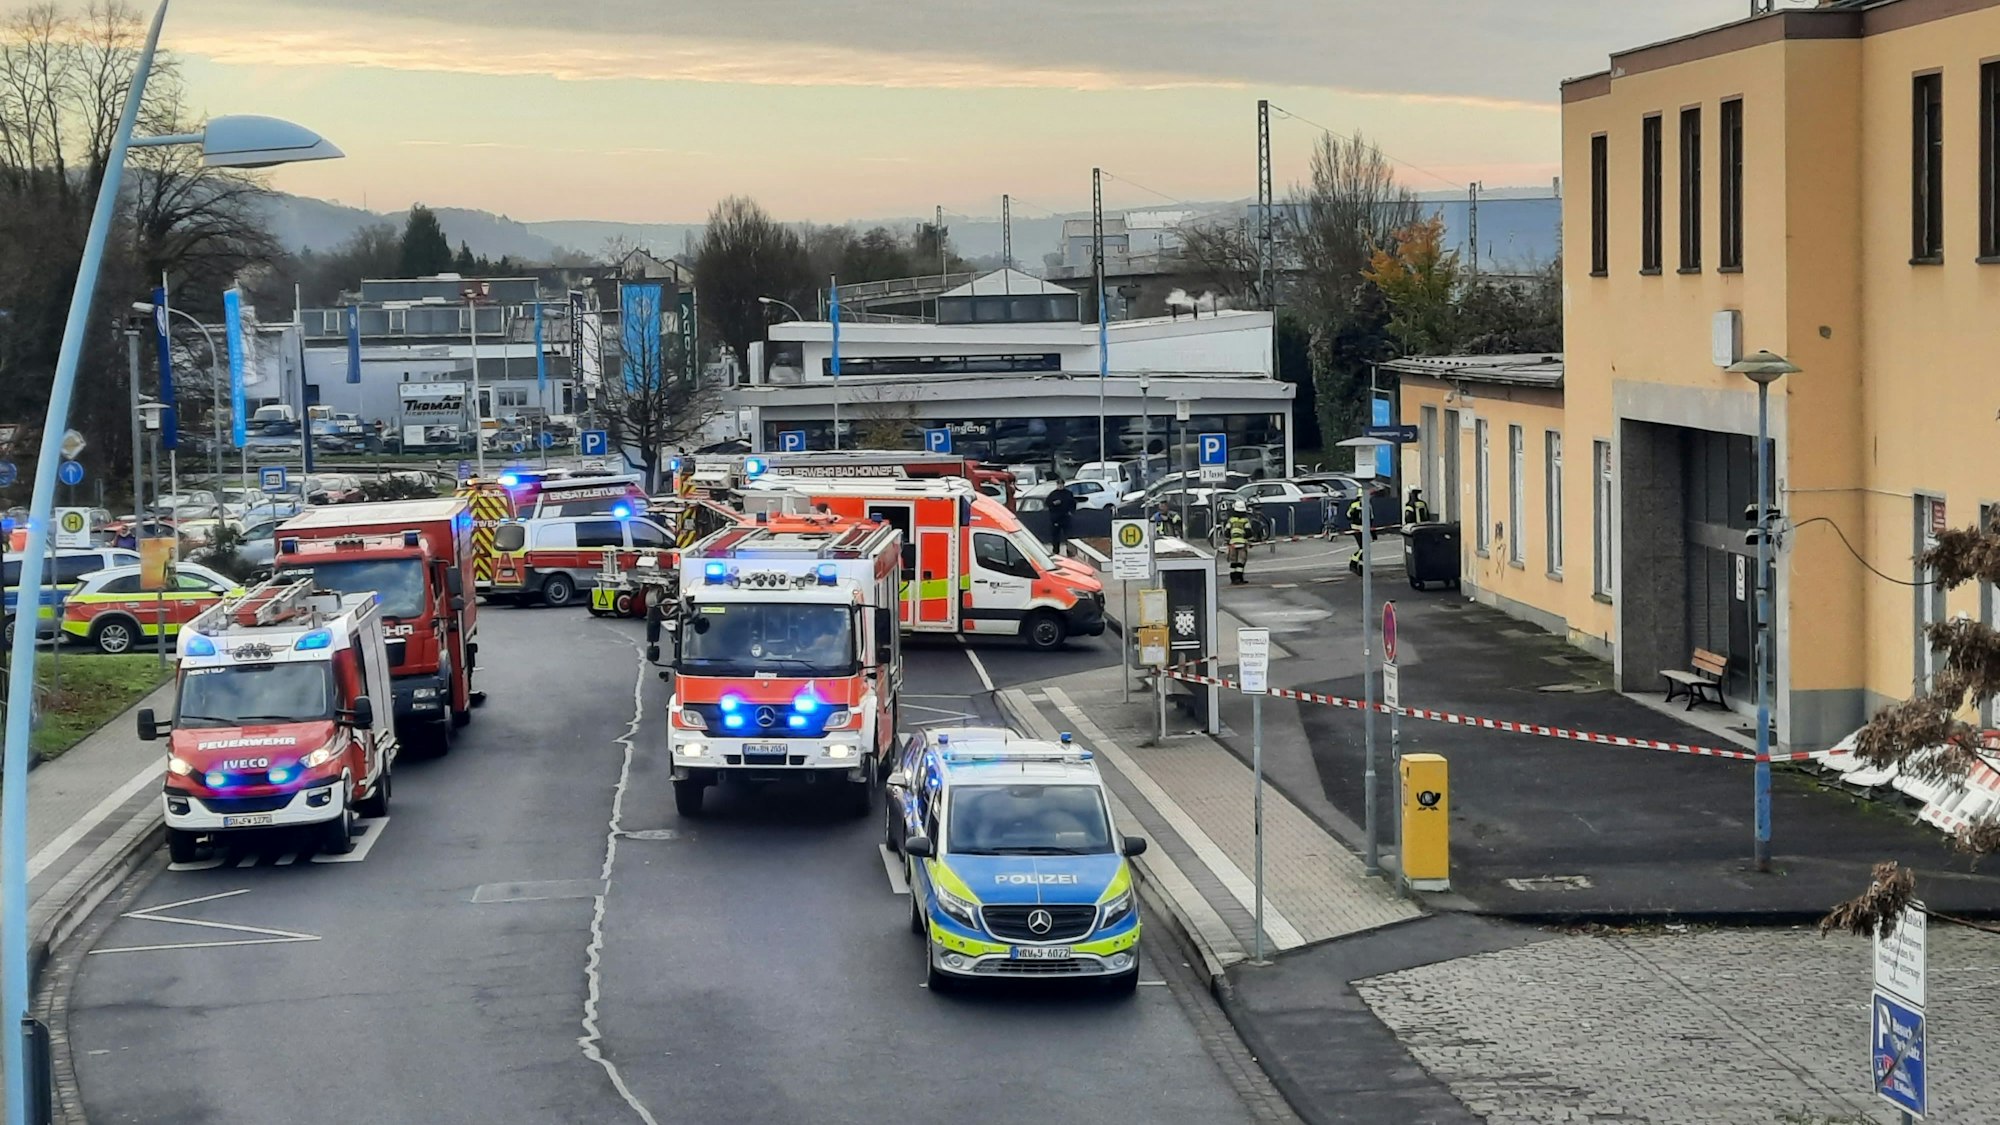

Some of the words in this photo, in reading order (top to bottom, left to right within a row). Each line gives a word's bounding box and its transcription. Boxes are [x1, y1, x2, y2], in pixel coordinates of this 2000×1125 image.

[945, 422, 986, 434] Eingang
[586, 434, 600, 454] P
[785, 434, 799, 452] P
[931, 432, 944, 451] P
[1205, 438, 1220, 462] P
[836, 466, 854, 477] BAD
[855, 465, 892, 477] HONNEF
[67, 516, 78, 531] H
[1125, 528, 1136, 543] H
[197, 736, 296, 750] FEUERWEHR
[223, 758, 268, 769] IVECO
[995, 874, 1077, 885] POLIZEI
[1878, 1003, 1891, 1049] P
